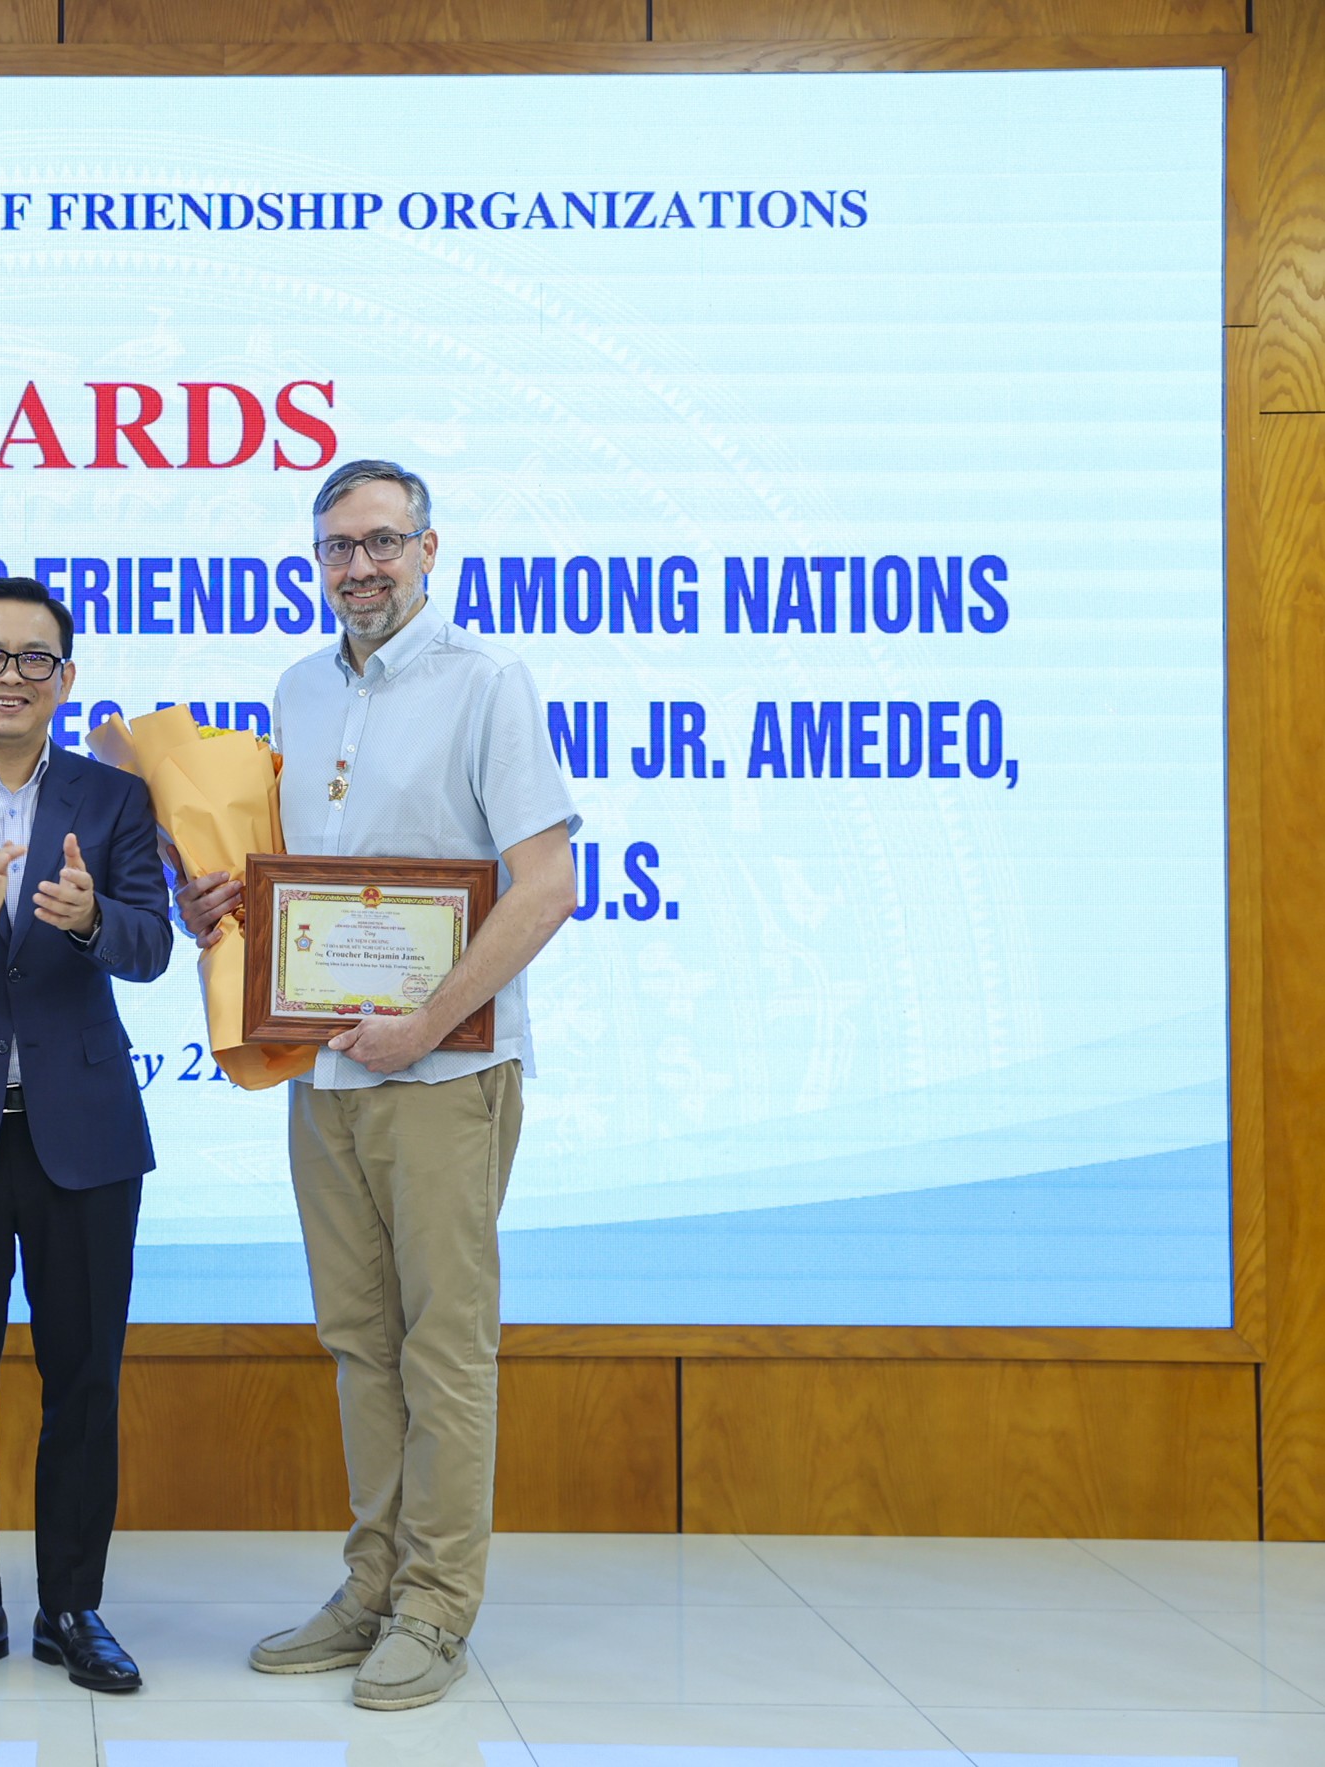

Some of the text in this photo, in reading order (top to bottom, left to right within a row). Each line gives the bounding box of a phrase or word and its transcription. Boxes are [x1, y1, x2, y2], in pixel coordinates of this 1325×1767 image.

[49, 193, 384, 232] FRIENDSHIP
[399, 191, 869, 231] ORGANIZATIONS
[454, 555, 700, 635] AMONG
[725, 554, 1010, 635] NATIONS
[631, 700, 726, 780] JR.
[747, 699, 1019, 790] AMEDEO,
[570, 841, 680, 922] U.S.
[326, 950, 362, 958] Croucher
[364, 951, 400, 961] Benjamin
[401, 953, 425, 961] James
